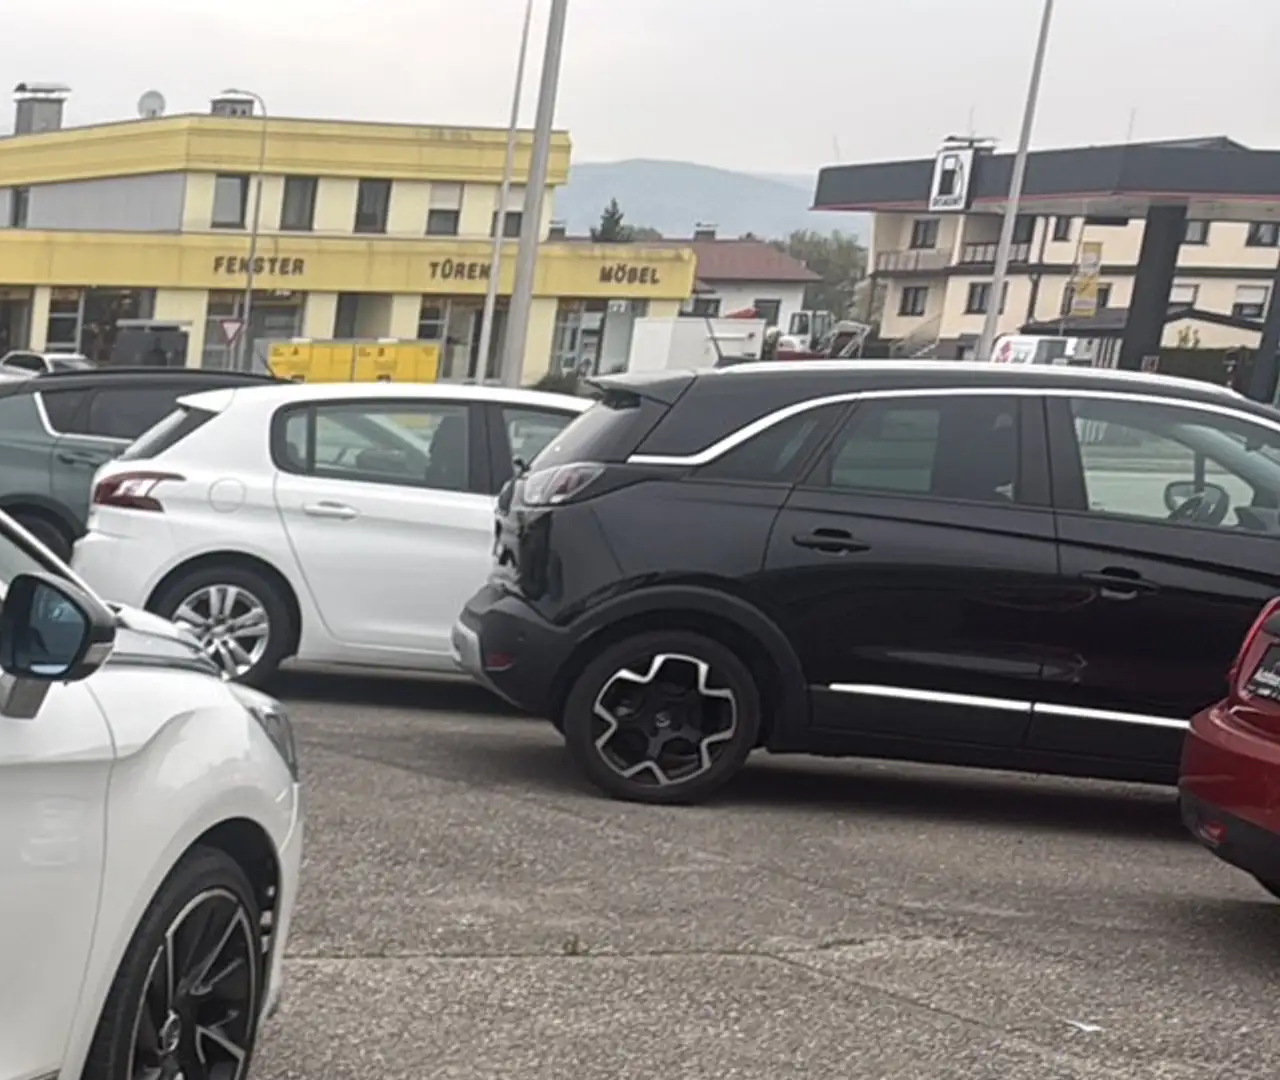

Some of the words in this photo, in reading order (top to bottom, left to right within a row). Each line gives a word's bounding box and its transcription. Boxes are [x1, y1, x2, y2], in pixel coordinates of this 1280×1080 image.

[213, 256, 305, 276] FENSTER
[429, 257, 492, 281] TÜREN
[599, 264, 660, 285] MÖBEL
